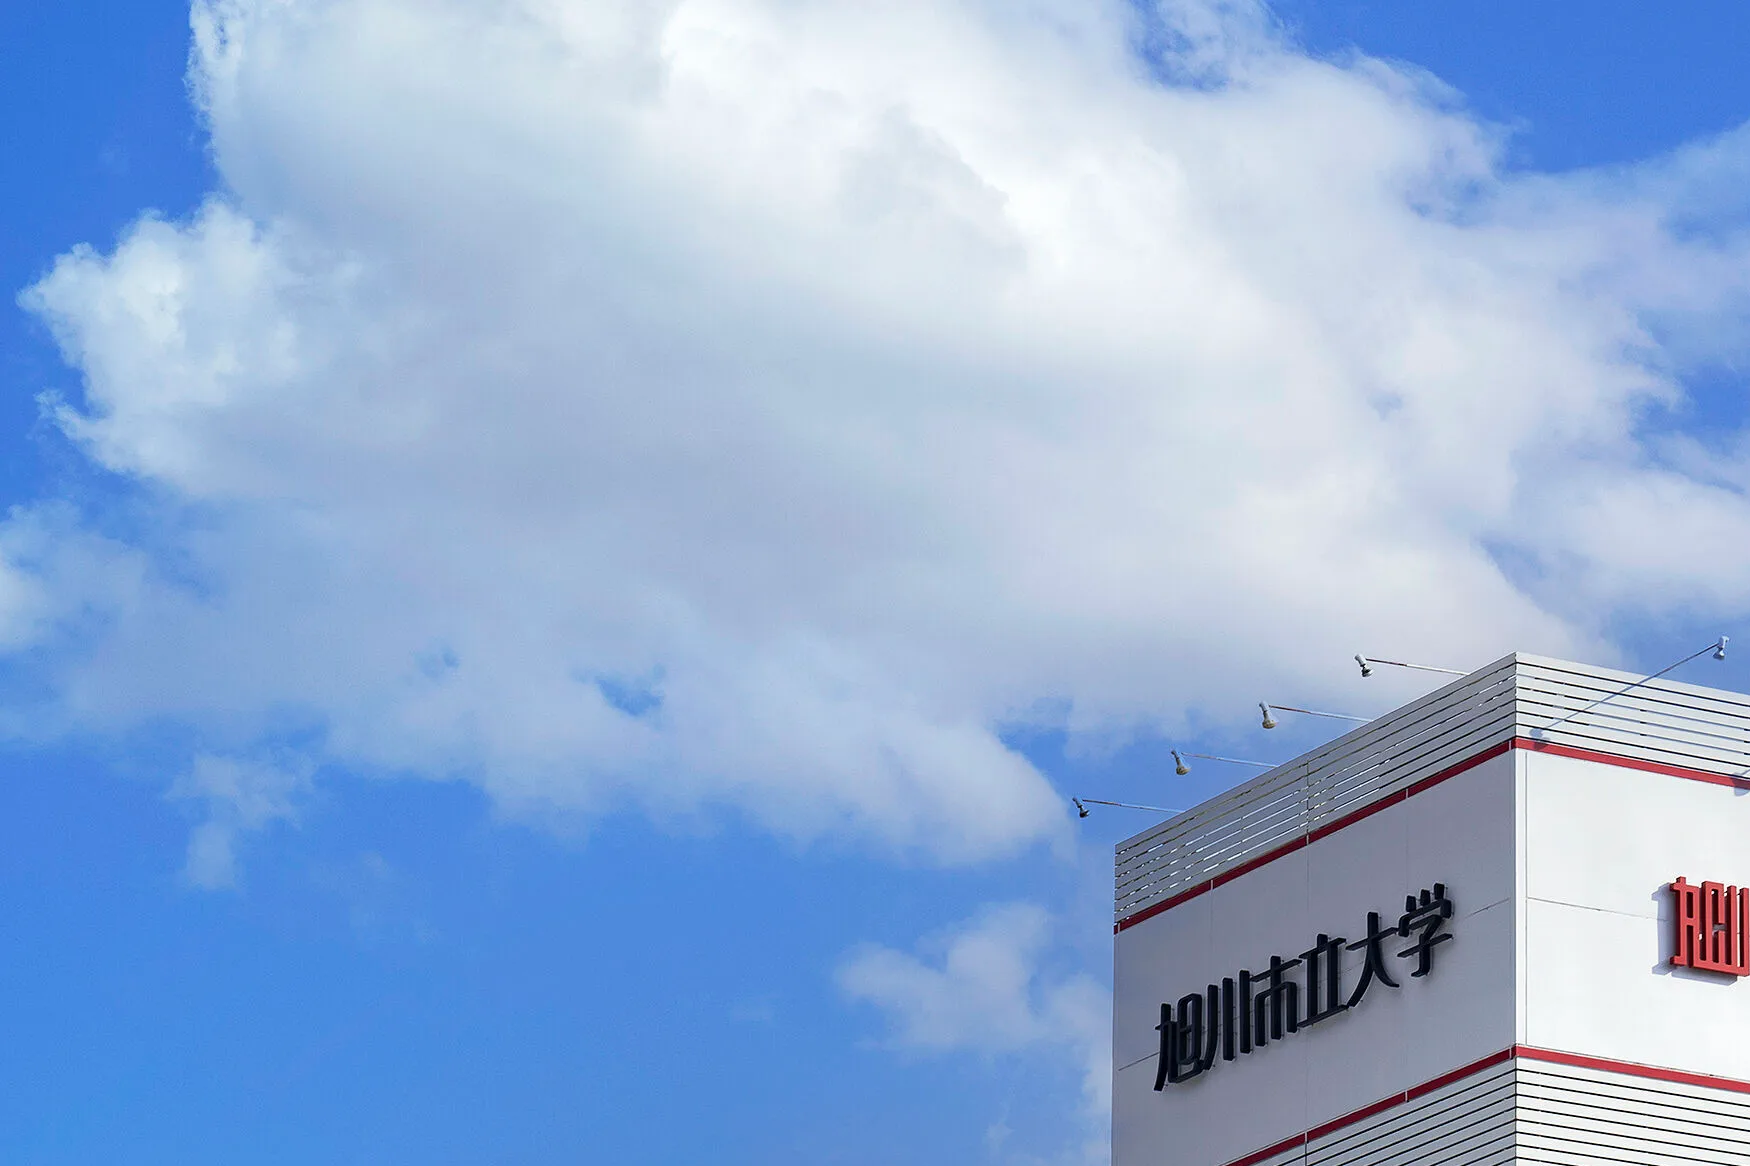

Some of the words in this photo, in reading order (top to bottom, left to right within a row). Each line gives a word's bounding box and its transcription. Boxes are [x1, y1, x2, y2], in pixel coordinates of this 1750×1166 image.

[1153, 882, 1454, 1092] 旭川市立大学
